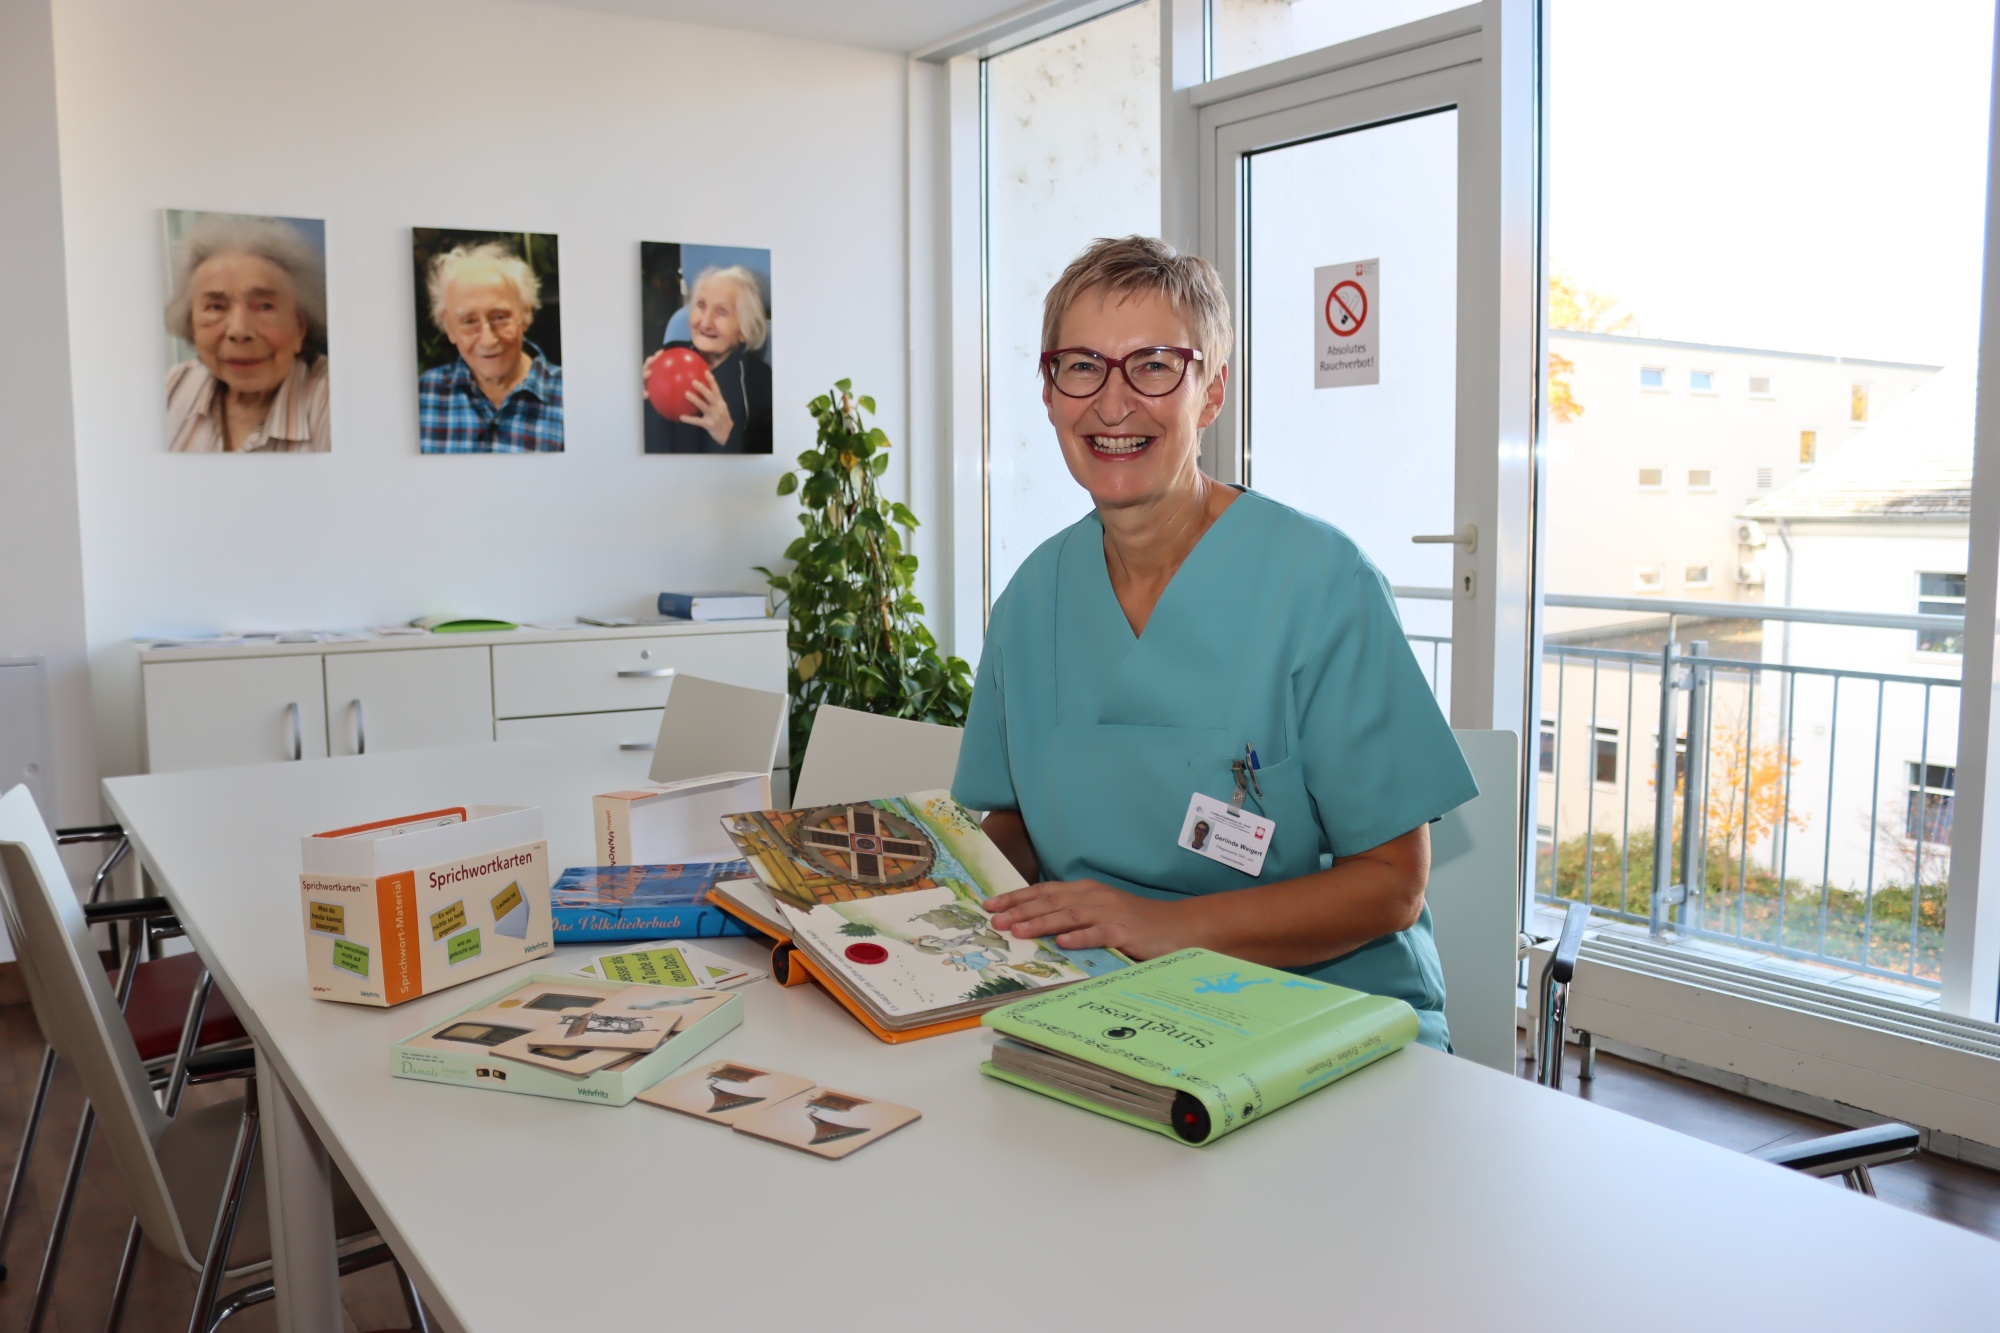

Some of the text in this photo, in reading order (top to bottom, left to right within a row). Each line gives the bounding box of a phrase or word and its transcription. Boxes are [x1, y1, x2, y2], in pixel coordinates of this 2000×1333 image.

[1327, 344, 1366, 356] Absolutes
[1320, 358, 1374, 372] Rauchverbot!
[1240, 844, 1262, 857] Weigert
[429, 852, 532, 891] Sprichwortkarten
[302, 880, 360, 892] Sprichwortkarten
[445, 906, 456, 916] wird
[312, 912, 342, 924] heute kannst
[552, 915, 680, 932] Das Volksliederbuch
[432, 920, 446, 931] nichts
[438, 922, 461, 938] gegessen
[392, 880, 410, 994] Sprichwort-Material
[524, 941, 548, 954] Wehrfritz
[631, 952, 650, 962] auf
[638, 962, 658, 980] Taube
[670, 969, 686, 982] dem
[1078, 1001, 1214, 1049] SingLiesel
[1362, 1036, 1382, 1048] Singen
[401, 1061, 439, 1078] Damals
[578, 1087, 608, 1098] Wehrfritz
